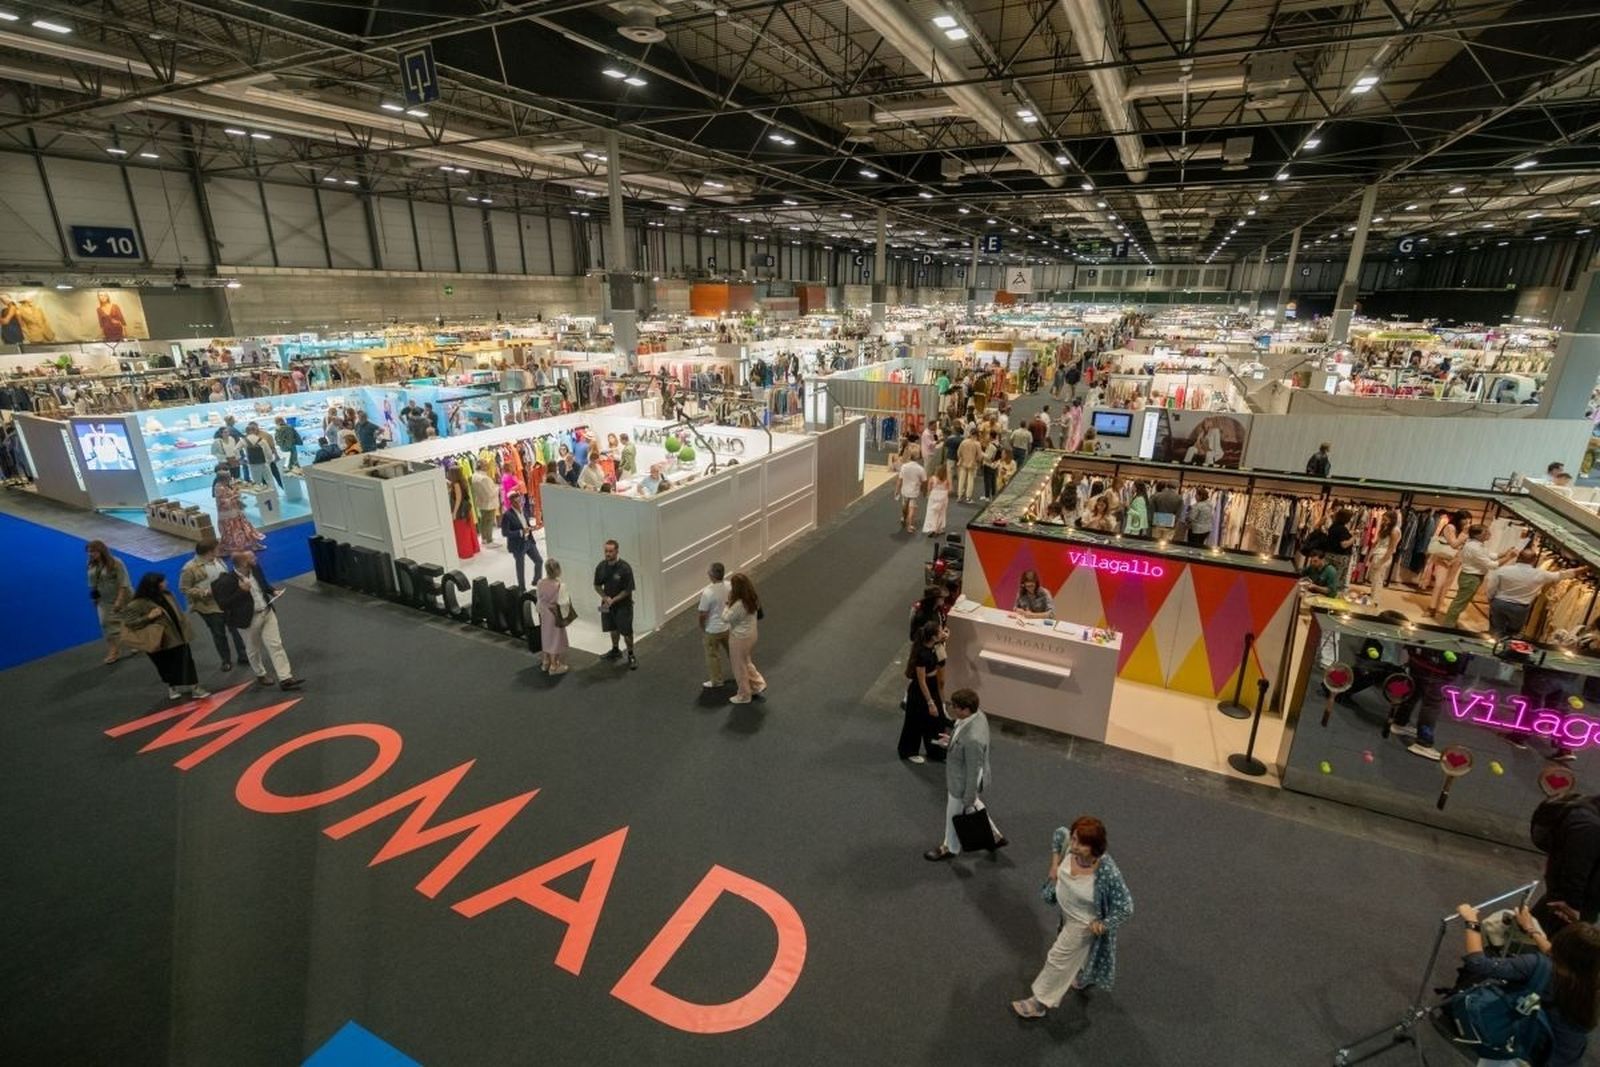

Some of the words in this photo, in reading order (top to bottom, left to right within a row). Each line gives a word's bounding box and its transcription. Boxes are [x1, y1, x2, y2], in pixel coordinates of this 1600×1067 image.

[106, 237, 133, 255] 10
[988, 236, 997, 250] E
[1115, 243, 1125, 257] F
[1399, 239, 1413, 253] G
[855, 256, 863, 265] C
[923, 255, 931, 265] D
[1069, 550, 1164, 577] Vilagallo
[104, 680, 807, 1034] MOMAD
